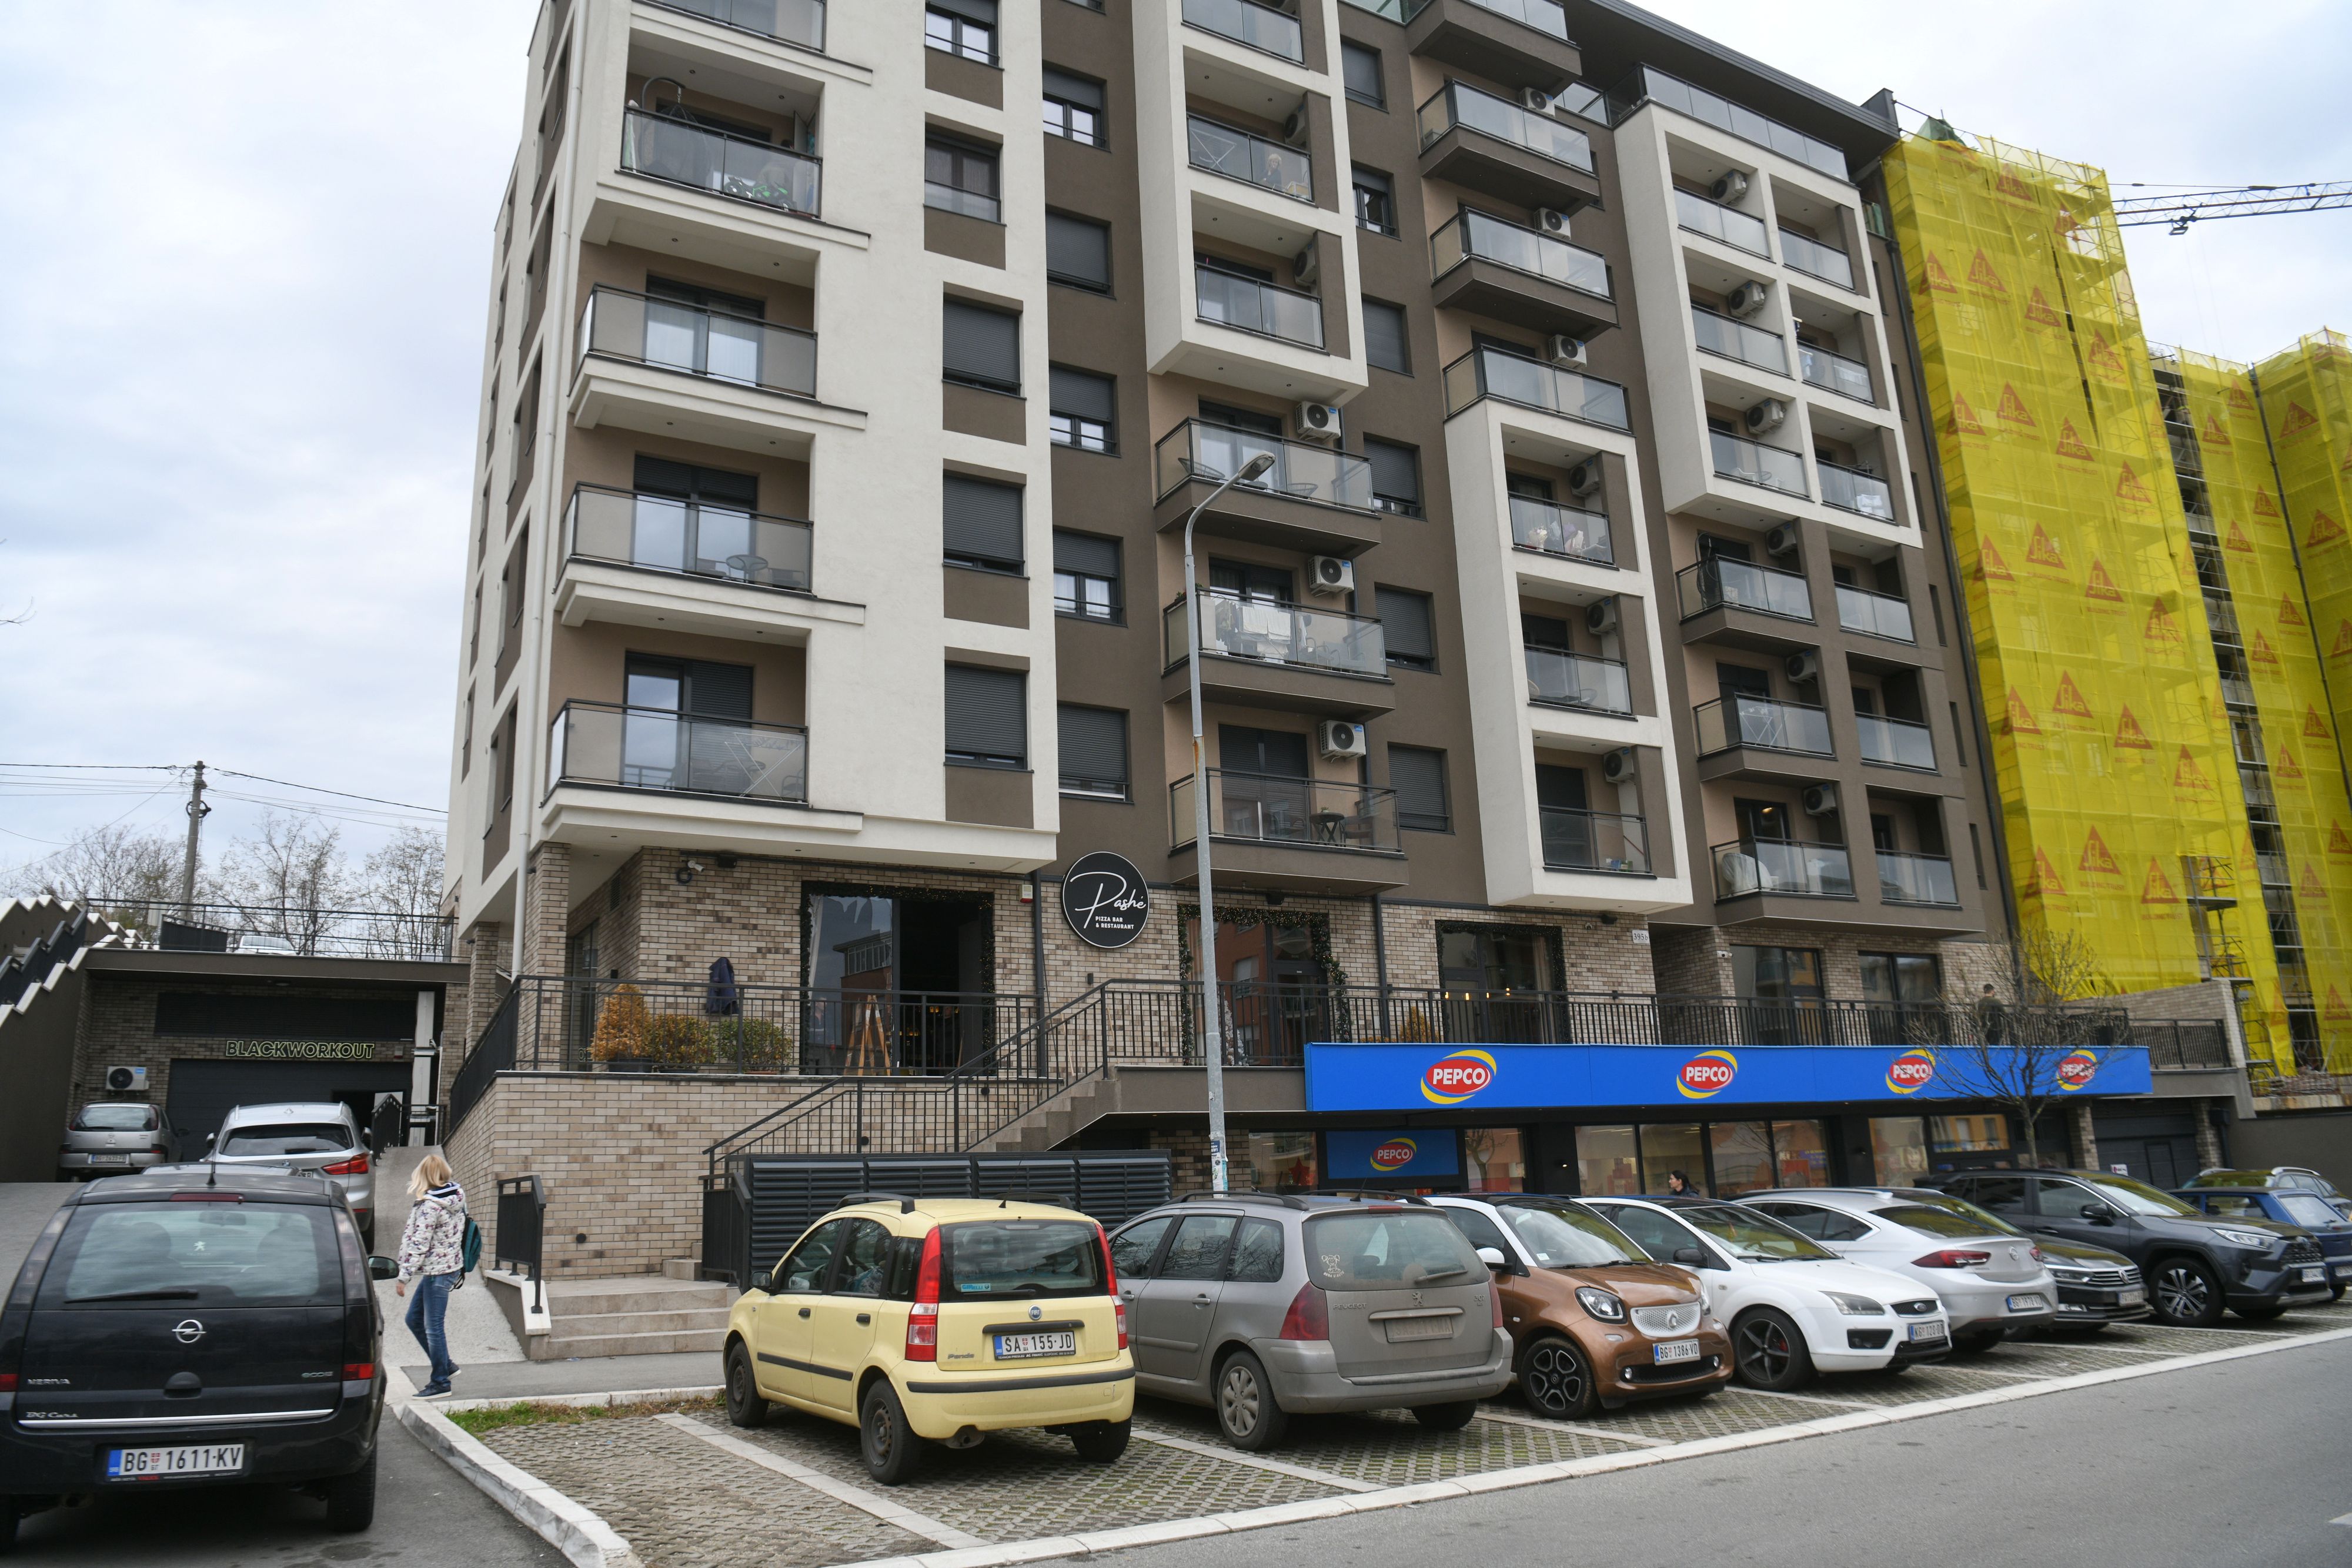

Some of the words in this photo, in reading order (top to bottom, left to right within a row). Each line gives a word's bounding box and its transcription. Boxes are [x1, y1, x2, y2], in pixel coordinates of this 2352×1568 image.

[1999, 394, 2029, 420] Sika
[2060, 430, 2087, 456] Sika
[2029, 536, 2059, 564] Sika
[2089, 570, 2116, 597] Sika
[2056, 684, 2086, 713] Sika
[2119, 717, 2146, 744] Sika
[2083, 840, 2113, 869] Sika
[2147, 872, 2173, 899] Sika
[1070, 871, 1146, 929] Pashé
[226, 1041, 375, 1058] BLACKWORKOUT
[1433, 1068, 1486, 1085] PEPCO
[1686, 1066, 1729, 1082] PEPCO
[1893, 1064, 1929, 1078] PEPCO
[1378, 1149, 1409, 1159] PEPCO
[1005, 1337, 1021, 1352] ŠA
[1660, 1347, 1668, 1359] BG
[124, 1452, 147, 1472] BG
